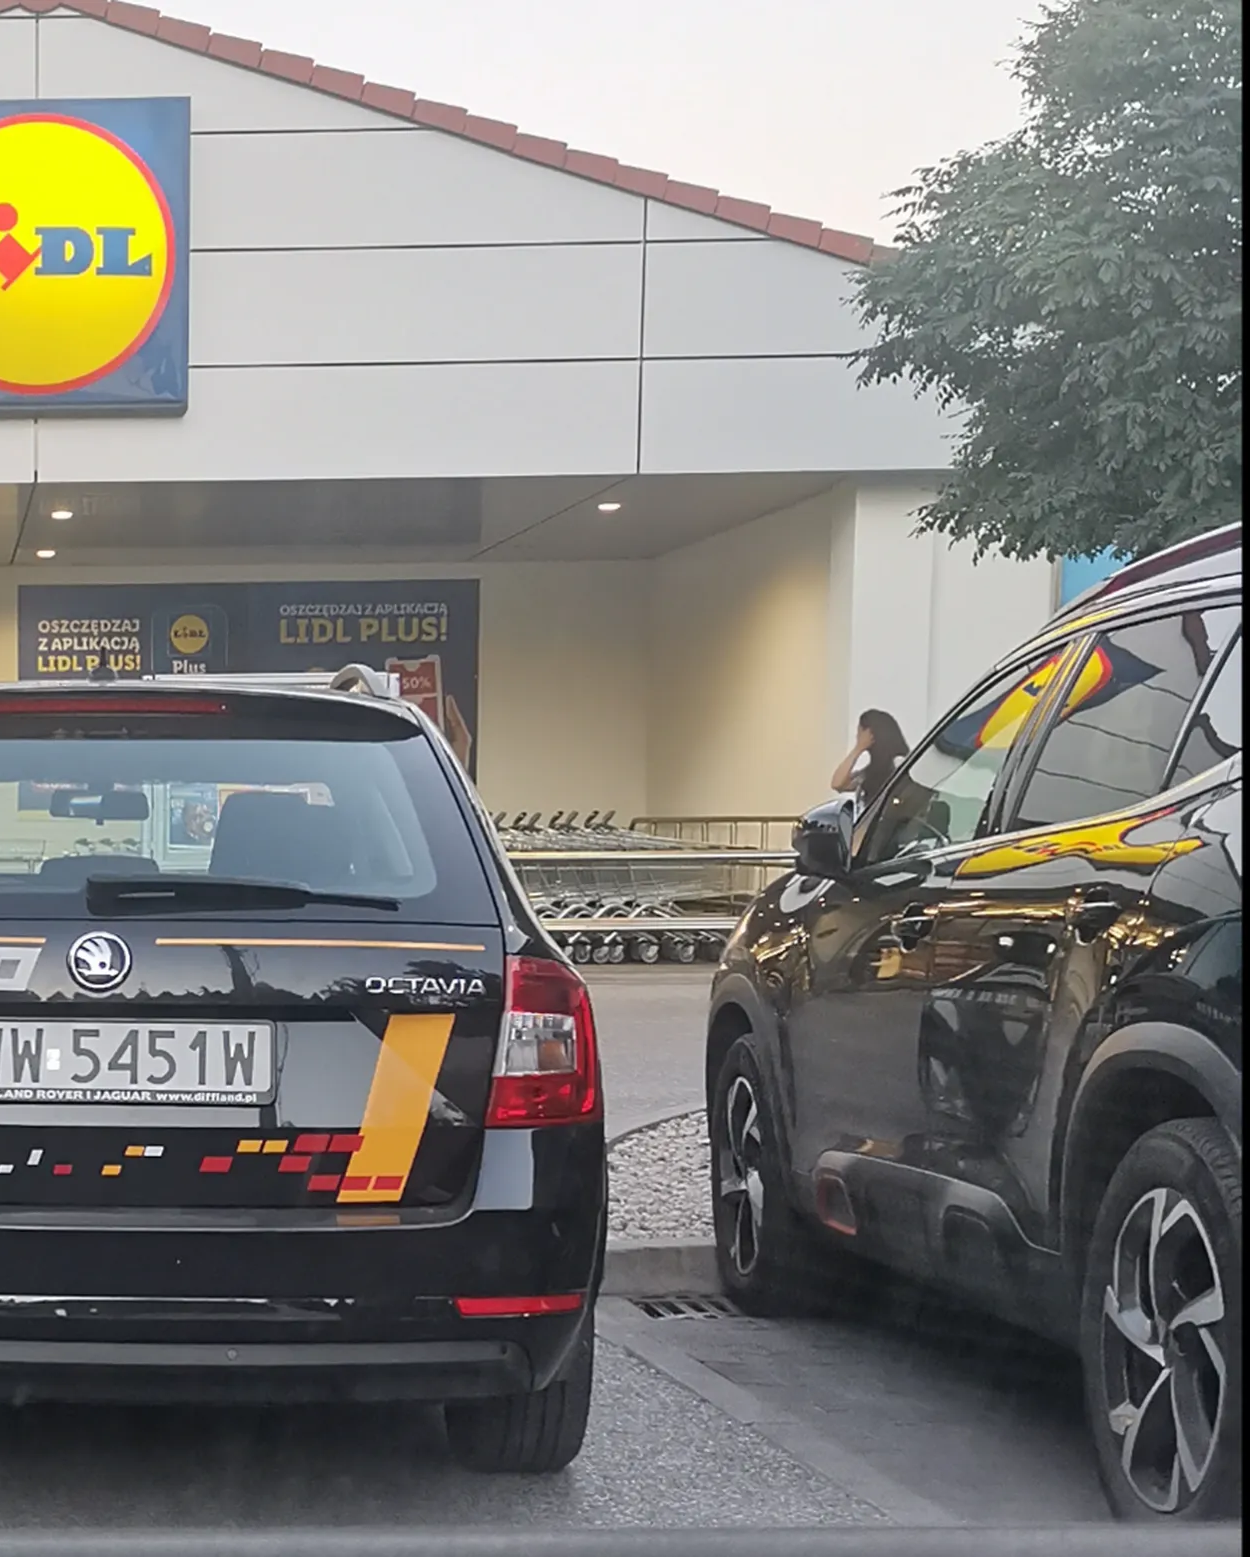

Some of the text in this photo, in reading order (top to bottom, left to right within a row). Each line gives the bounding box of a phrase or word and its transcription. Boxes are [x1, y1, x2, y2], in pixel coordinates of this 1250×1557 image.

[280, 603, 448, 617] OSZCZĘDZAJ Z APLIKACJĄ
[37, 619, 140, 635] OSZCZĘDZAJ
[279, 616, 448, 643] LIDL PLUS!
[37, 636, 140, 653] Z APLIKACJĄ
[37, 655, 141, 672] LIDL PUS!
[172, 660, 206, 674] Plus
[365, 976, 485, 995] OCTAVIA
[70, 1028, 256, 1086] 5451W
[36, 1089, 83, 1100] ROVER
[93, 1090, 152, 1101] JAGUAR
